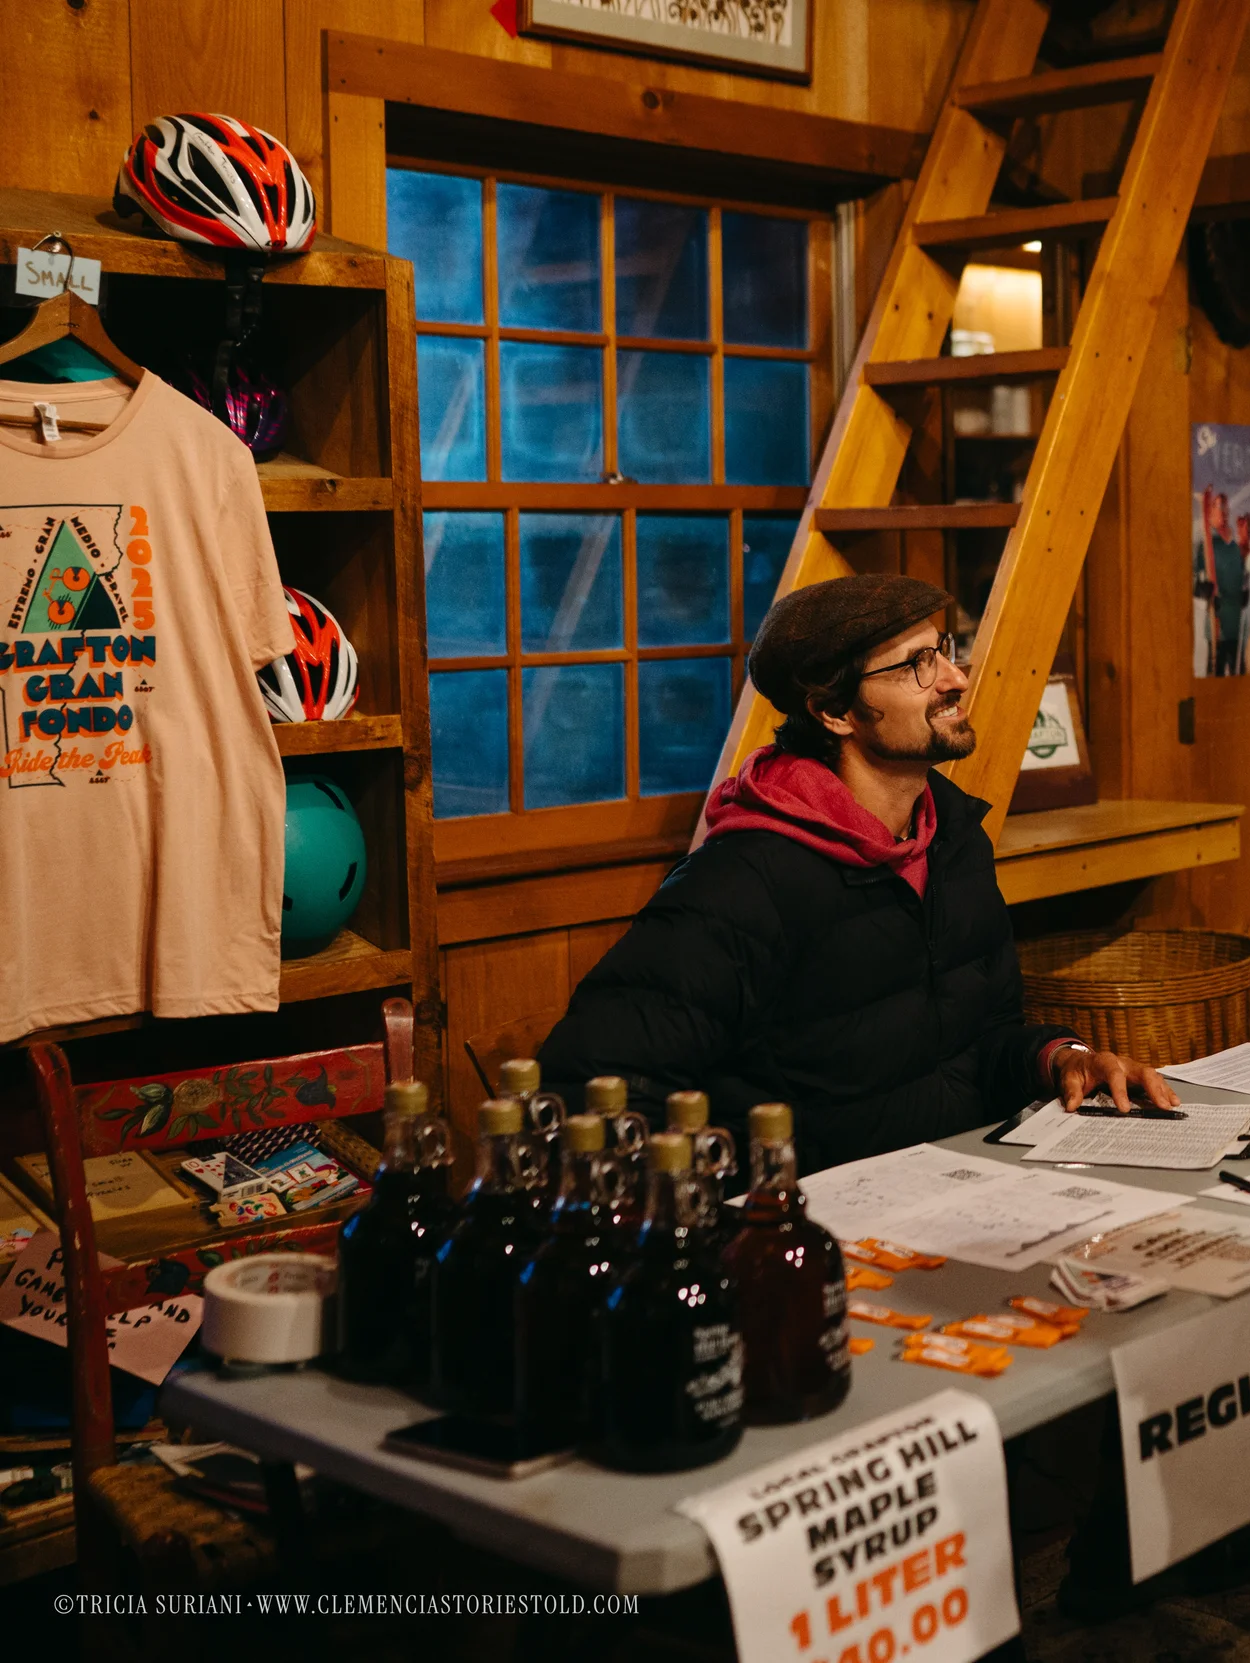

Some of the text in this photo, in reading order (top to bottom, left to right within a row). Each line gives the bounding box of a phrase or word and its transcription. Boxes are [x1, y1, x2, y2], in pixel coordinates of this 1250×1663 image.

[25, 260, 94, 292] SMALL
[7, 516, 56, 629] ESTREMO GRAN
[71, 516, 129, 623] MEDIO GRAVEL
[126, 505, 156, 631] 2025
[0, 634, 156, 674] GRAFTON
[24, 671, 124, 705] GRAN
[0, 746, 54, 778] Ride
[56, 746, 96, 769] the
[20, 704, 133, 741] FONDO
[737, 1420, 978, 1546] SPRING HILL
[805, 1471, 938, 1553] MAPLE
[813, 1505, 940, 1588] SYRUP
[789, 1530, 968, 1652] 1 LITER
[811, 1587, 969, 1663] 40.00
